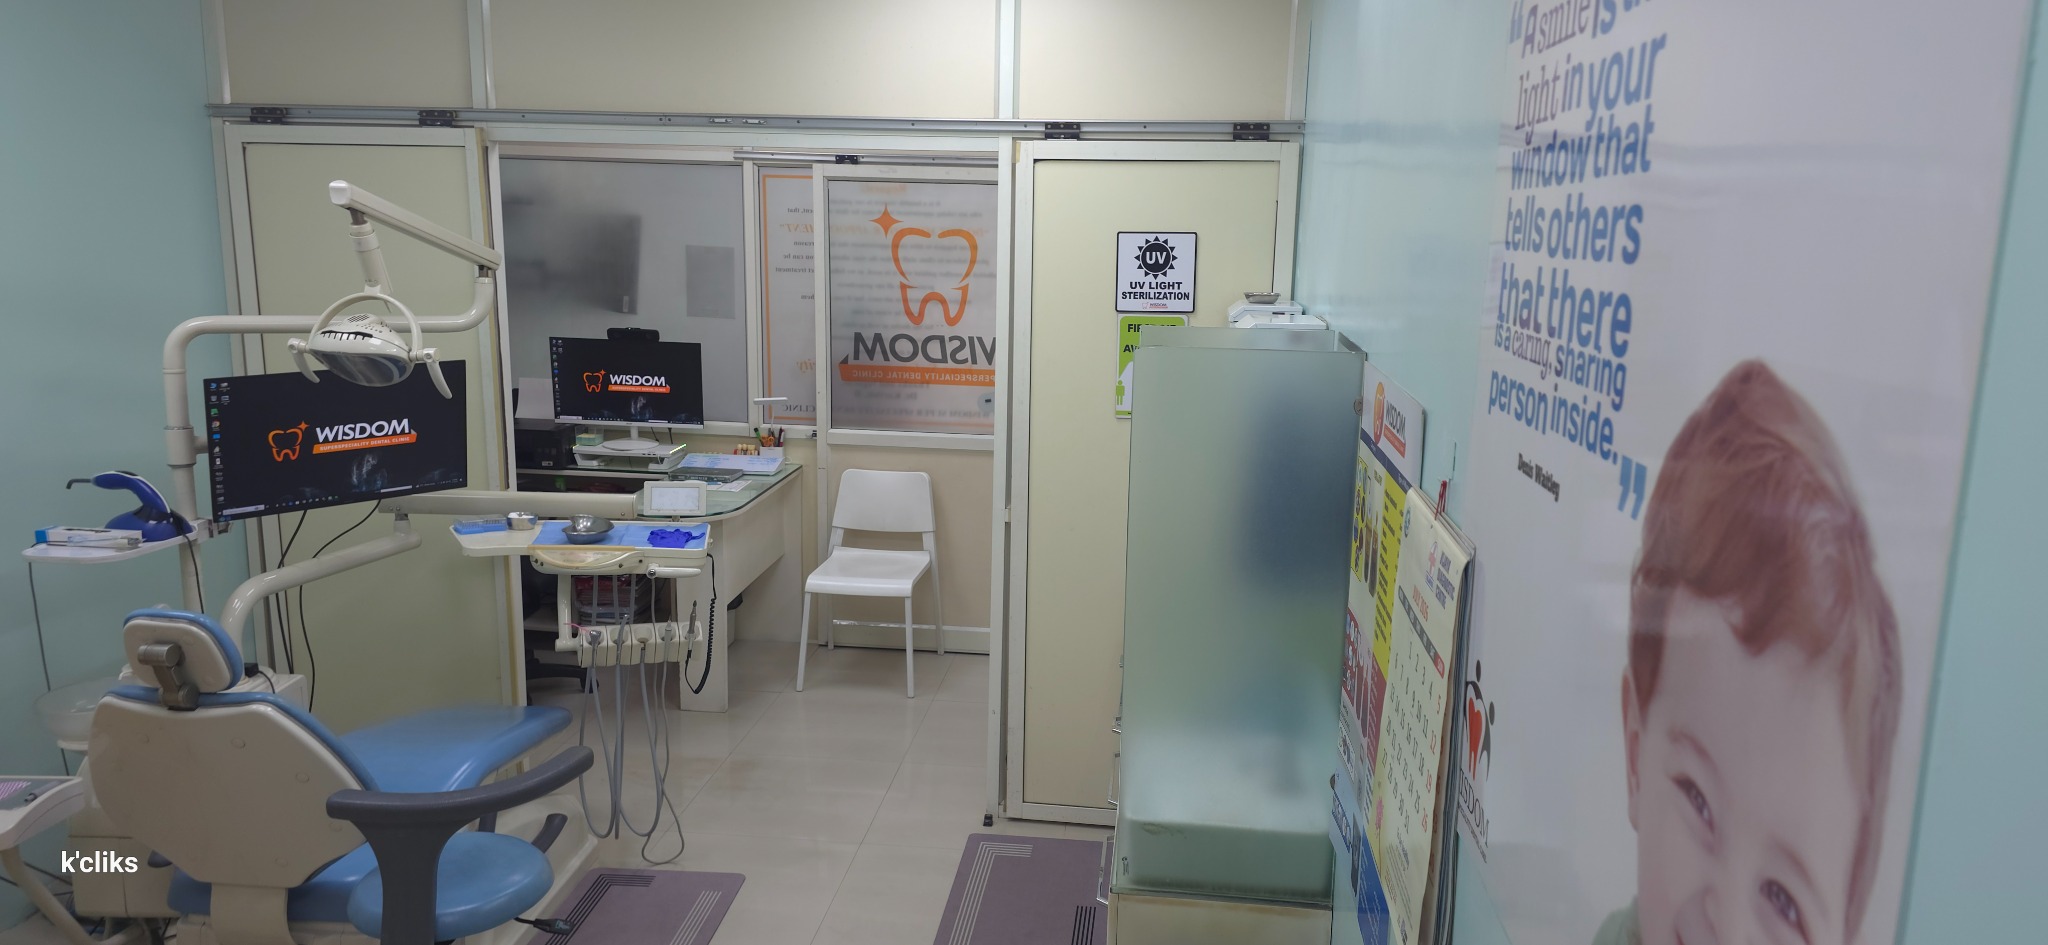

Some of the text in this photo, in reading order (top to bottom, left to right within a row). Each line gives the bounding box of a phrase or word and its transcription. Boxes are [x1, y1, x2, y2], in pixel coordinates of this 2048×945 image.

[1515, 32, 1667, 146] light in your
[1511, 103, 1655, 190] window that
[1505, 191, 1644, 265] tells others
[1129, 281, 1182, 290] UV LIGHT
[1146, 252, 1167, 264] UV
[1121, 291, 1190, 301] STERILIZATION
[1497, 262, 1632, 358] that there
[609, 374, 666, 387] WISDOM
[1494, 323, 1628, 412] is a caring, sharing
[316, 418, 409, 443] WISDOM
[1488, 369, 1549, 436] person
[320, 441, 370, 451] SUPERSPECIALITY
[1517, 452, 1561, 503] Denis Waitley
[1460, 768, 1490, 849] ISDOM
